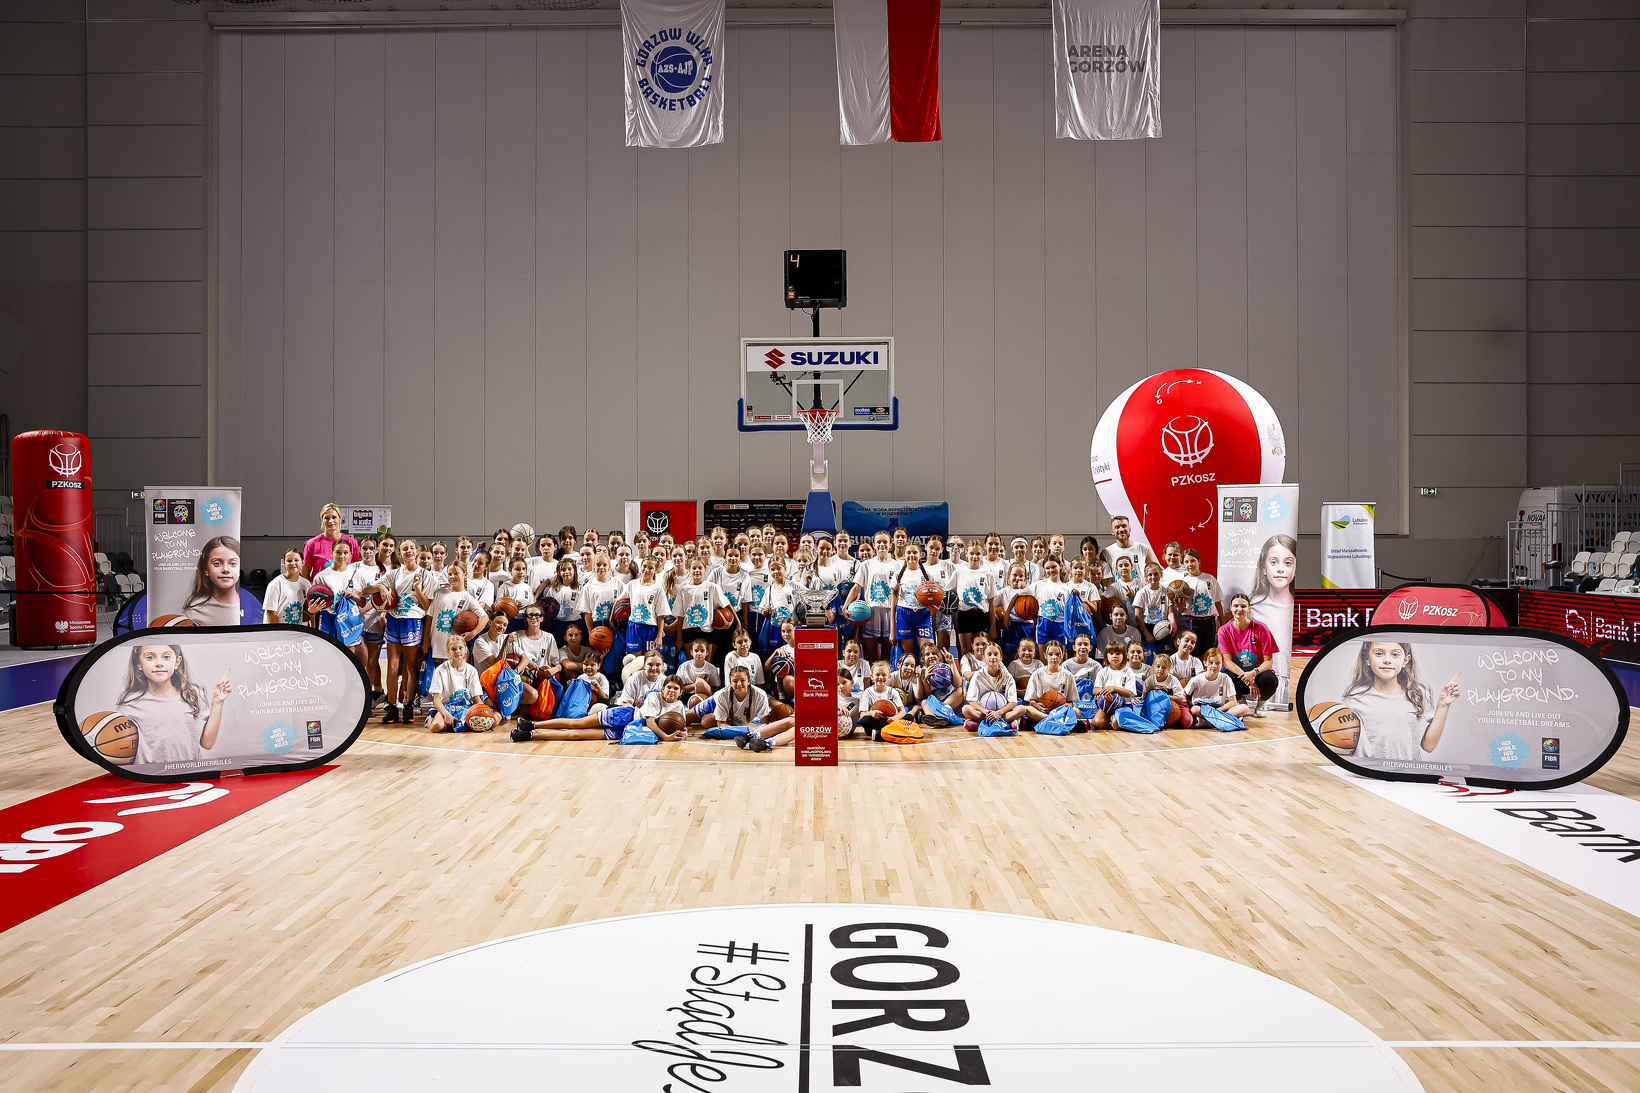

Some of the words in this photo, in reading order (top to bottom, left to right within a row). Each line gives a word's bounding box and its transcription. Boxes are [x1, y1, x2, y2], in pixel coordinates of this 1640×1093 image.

[636, 27, 682, 68] GORZÓW
[1068, 45, 1129, 58] ARENA
[1069, 57, 1147, 74] GORZÓW
[638, 75, 712, 111] BASKETBALL
[790, 351, 879, 366] SUZUKI
[1306, 607, 1360, 628] Bank
[1595, 617, 1630, 642] Bank
[261, 662, 280, 676] TO
[1496, 669, 1517, 684] TO
[1466, 684, 1579, 709] PLAYGROUND.
[266, 706, 303, 714] BASKETBALL
[799, 725, 832, 733] GORZÓW
[1496, 718, 1539, 726] BASKETBALL
[1540, 720, 1572, 729] DREAMS.
[164, 758, 232, 771] #HERWORLDHERRULES
[1382, 761, 1453, 772] #HERWORLDHERRULES
[829, 922, 991, 1093] GORZ
